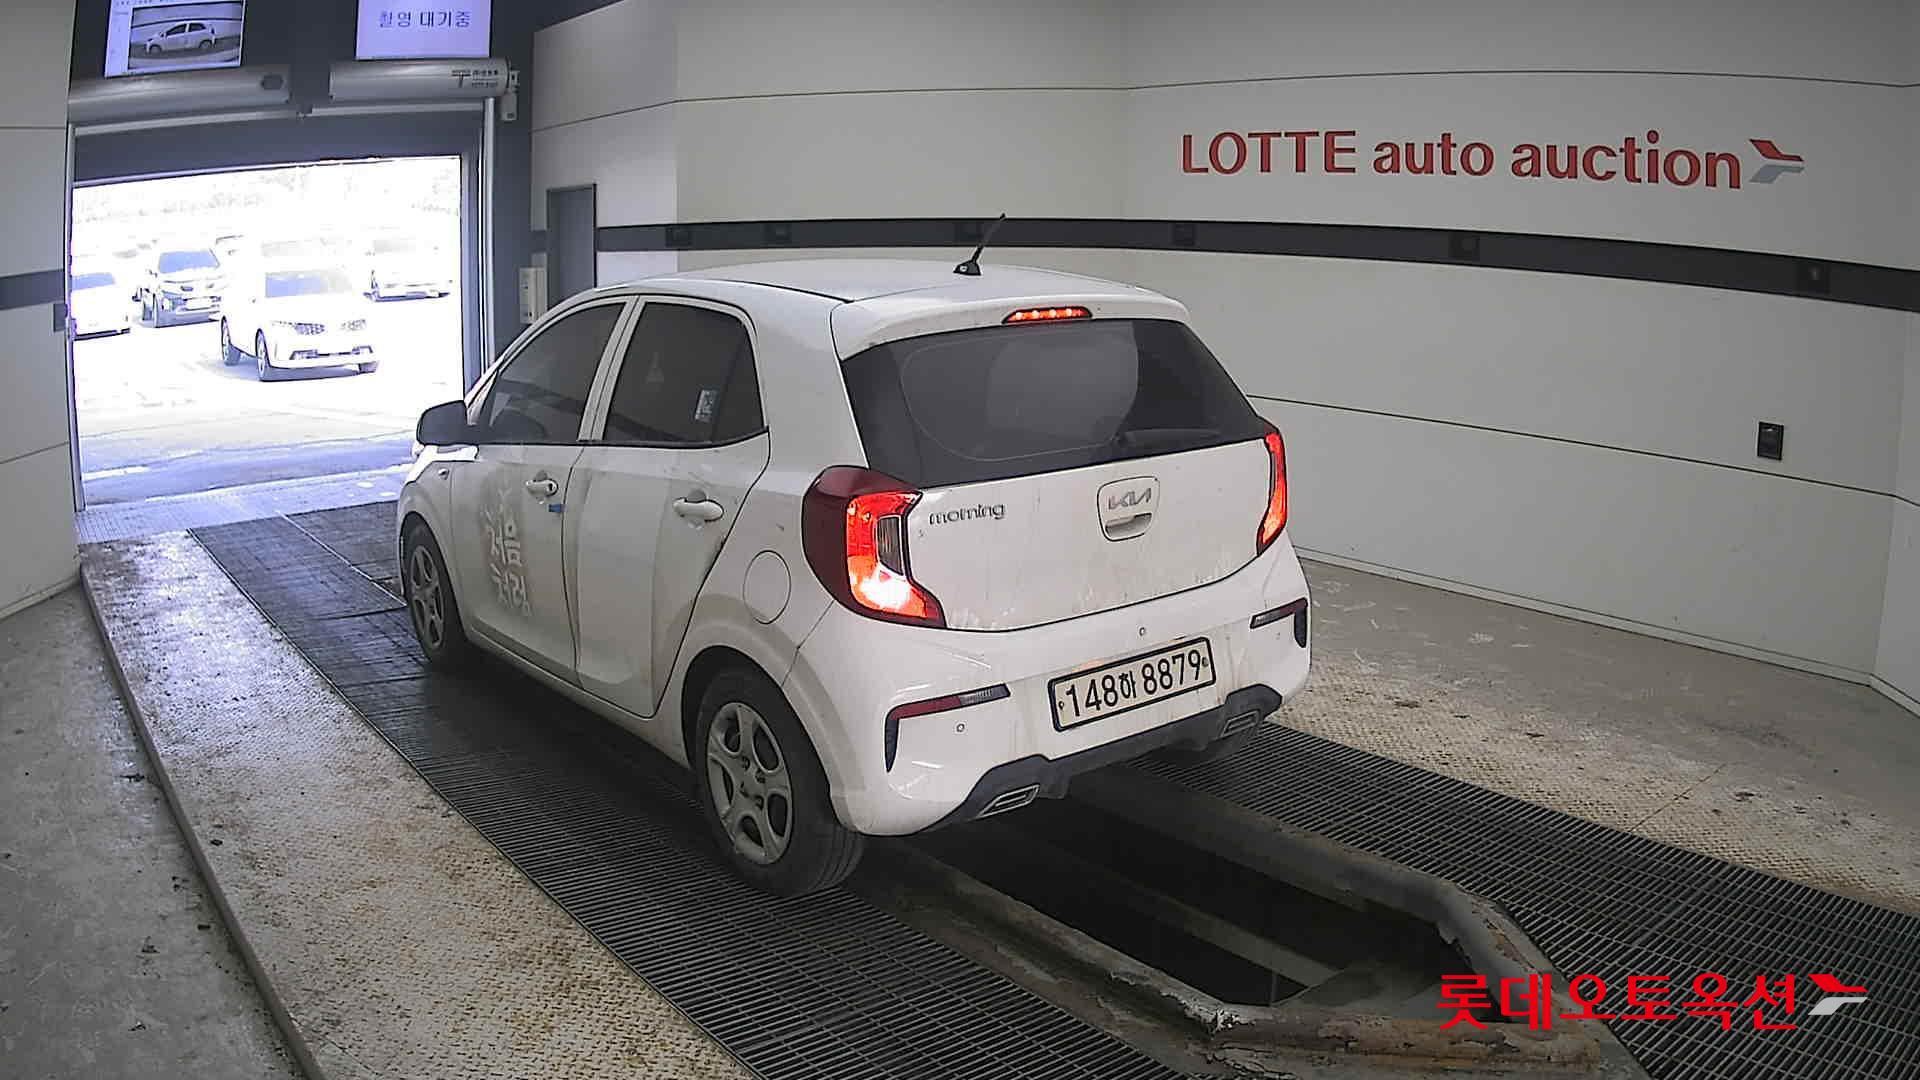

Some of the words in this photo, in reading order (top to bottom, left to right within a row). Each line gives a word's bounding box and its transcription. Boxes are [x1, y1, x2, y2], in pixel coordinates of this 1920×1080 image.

[419, 10, 471, 28] 대기중
[1181, 130, 1357, 175] LOTTE
[1372, 132, 1495, 176] auto
[1511, 130, 1741, 190] auction
[928, 502, 1006, 526] morning
[1141, 649, 1201, 695] 8879
